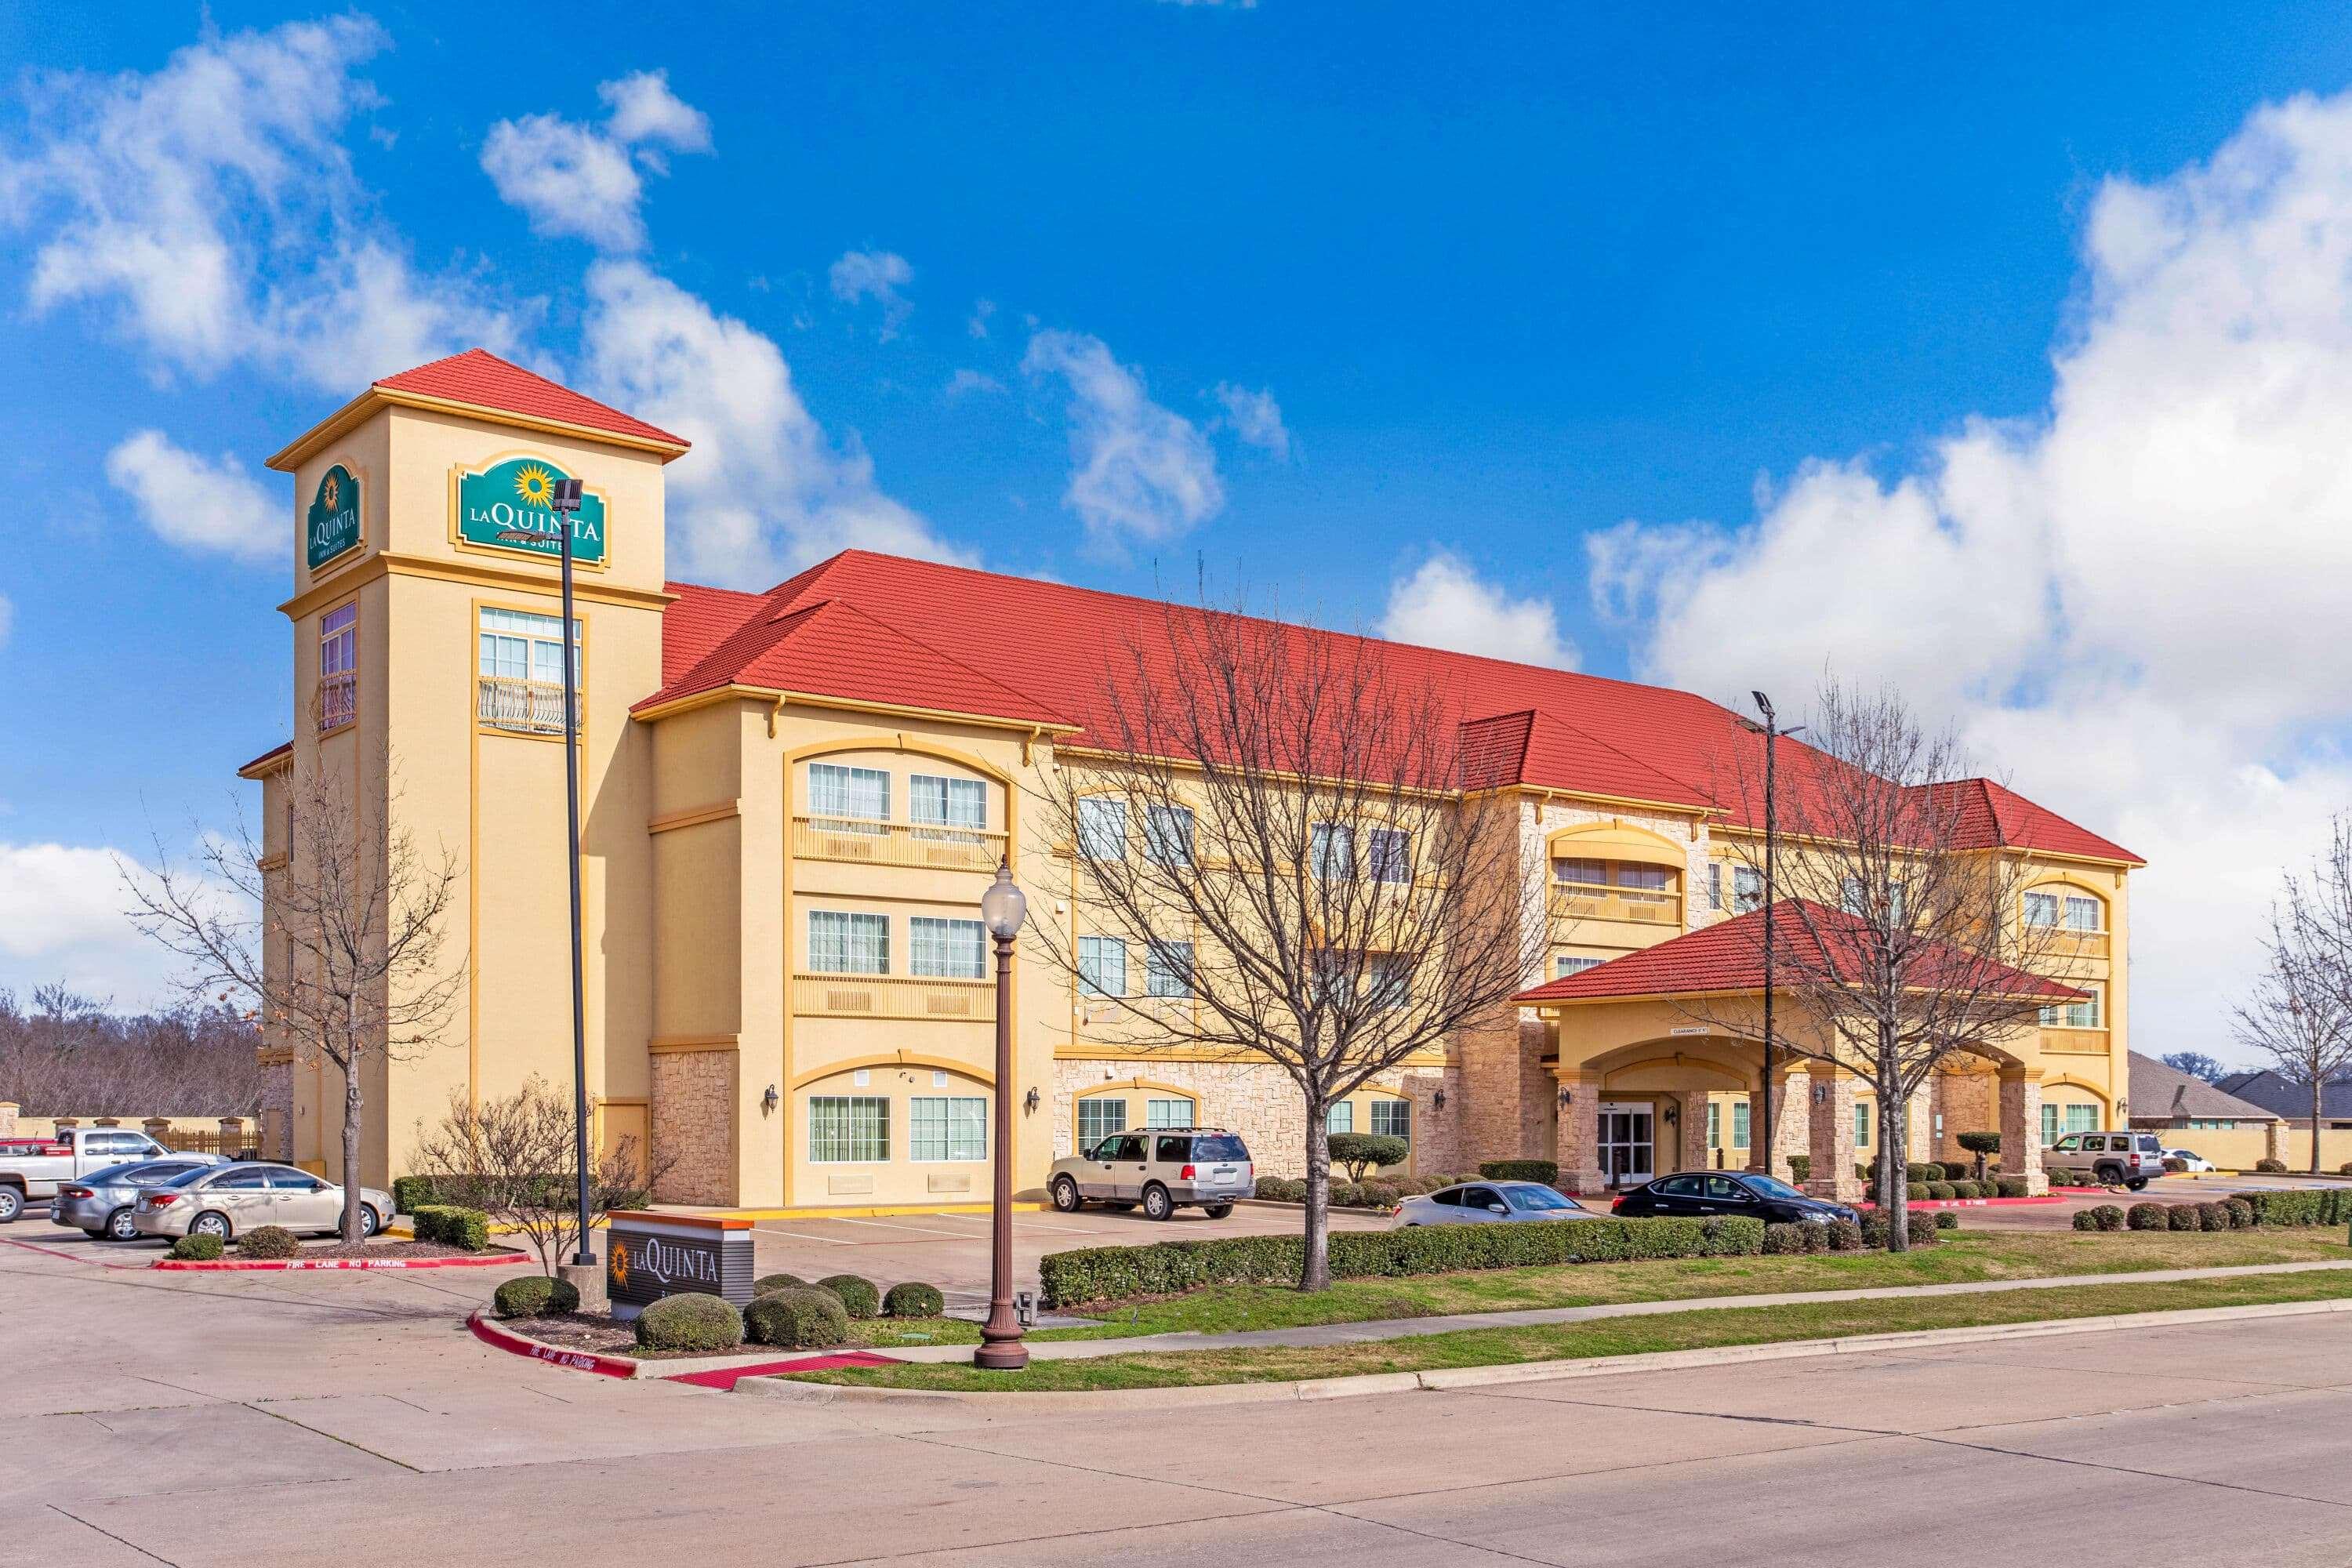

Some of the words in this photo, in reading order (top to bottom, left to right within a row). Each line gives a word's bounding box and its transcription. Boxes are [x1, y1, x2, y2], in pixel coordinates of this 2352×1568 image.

[470, 508, 490, 523] LA
[310, 537, 317, 550] LA
[317, 508, 355, 546] QUINTA
[287, 1260, 306, 1269] FIRE
[315, 1260, 339, 1269] LANE
[349, 1259, 361, 1268] NO
[368, 1259, 406, 1268] PARKING
[634, 1251, 646, 1271] LA
[646, 1238, 718, 1283] QUINTA
[559, 1353, 570, 1365] NO
[569, 1355, 595, 1370] PARKING
